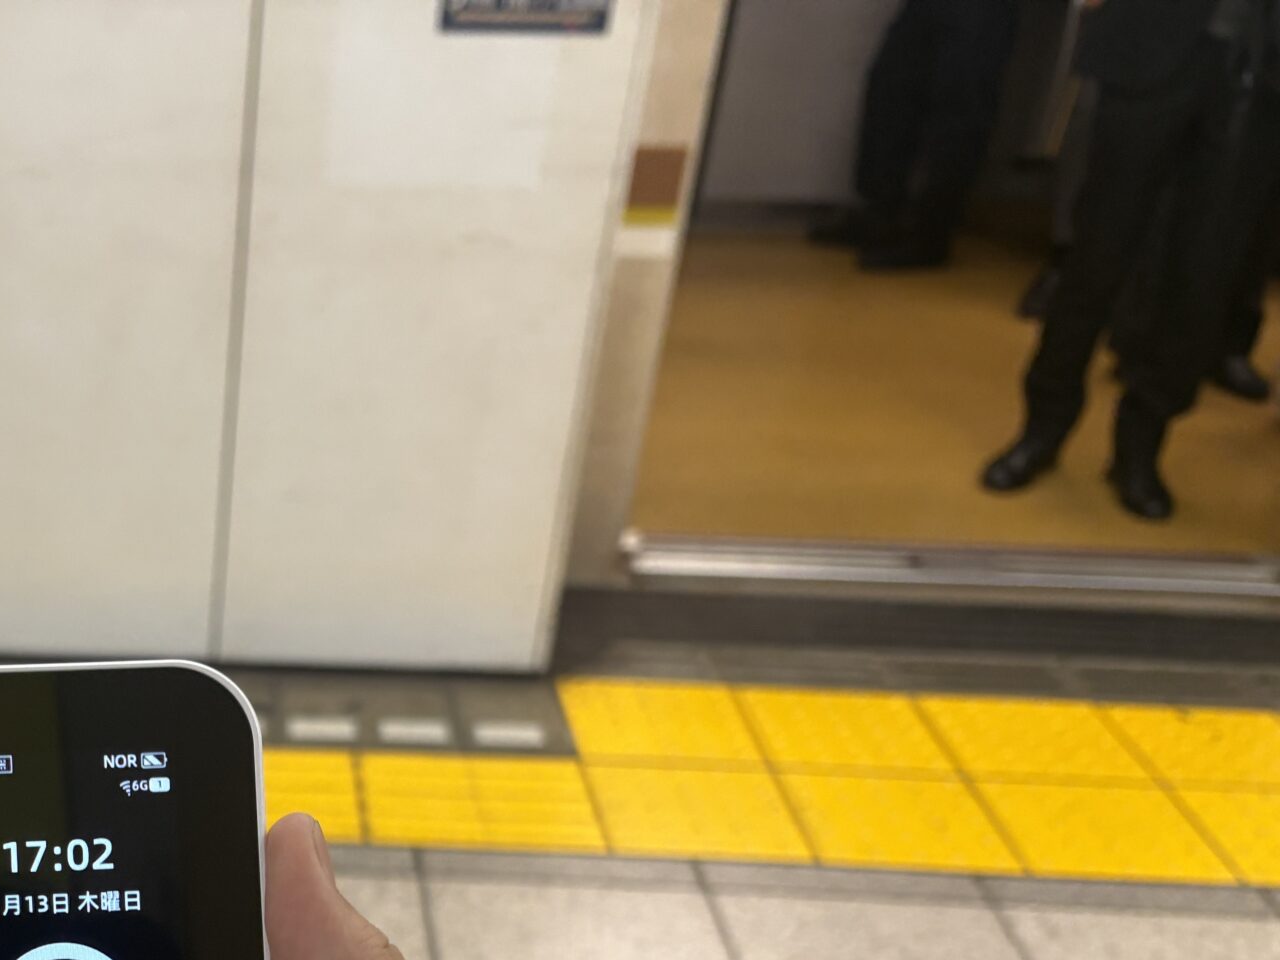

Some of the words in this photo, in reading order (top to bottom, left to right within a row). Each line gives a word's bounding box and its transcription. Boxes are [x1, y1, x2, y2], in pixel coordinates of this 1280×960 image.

[103, 754, 138, 769] NOR
[132, 779, 148, 791] 6G
[2, 838, 114, 873] 17:02
[77, 890, 142, 912] 木曜日
